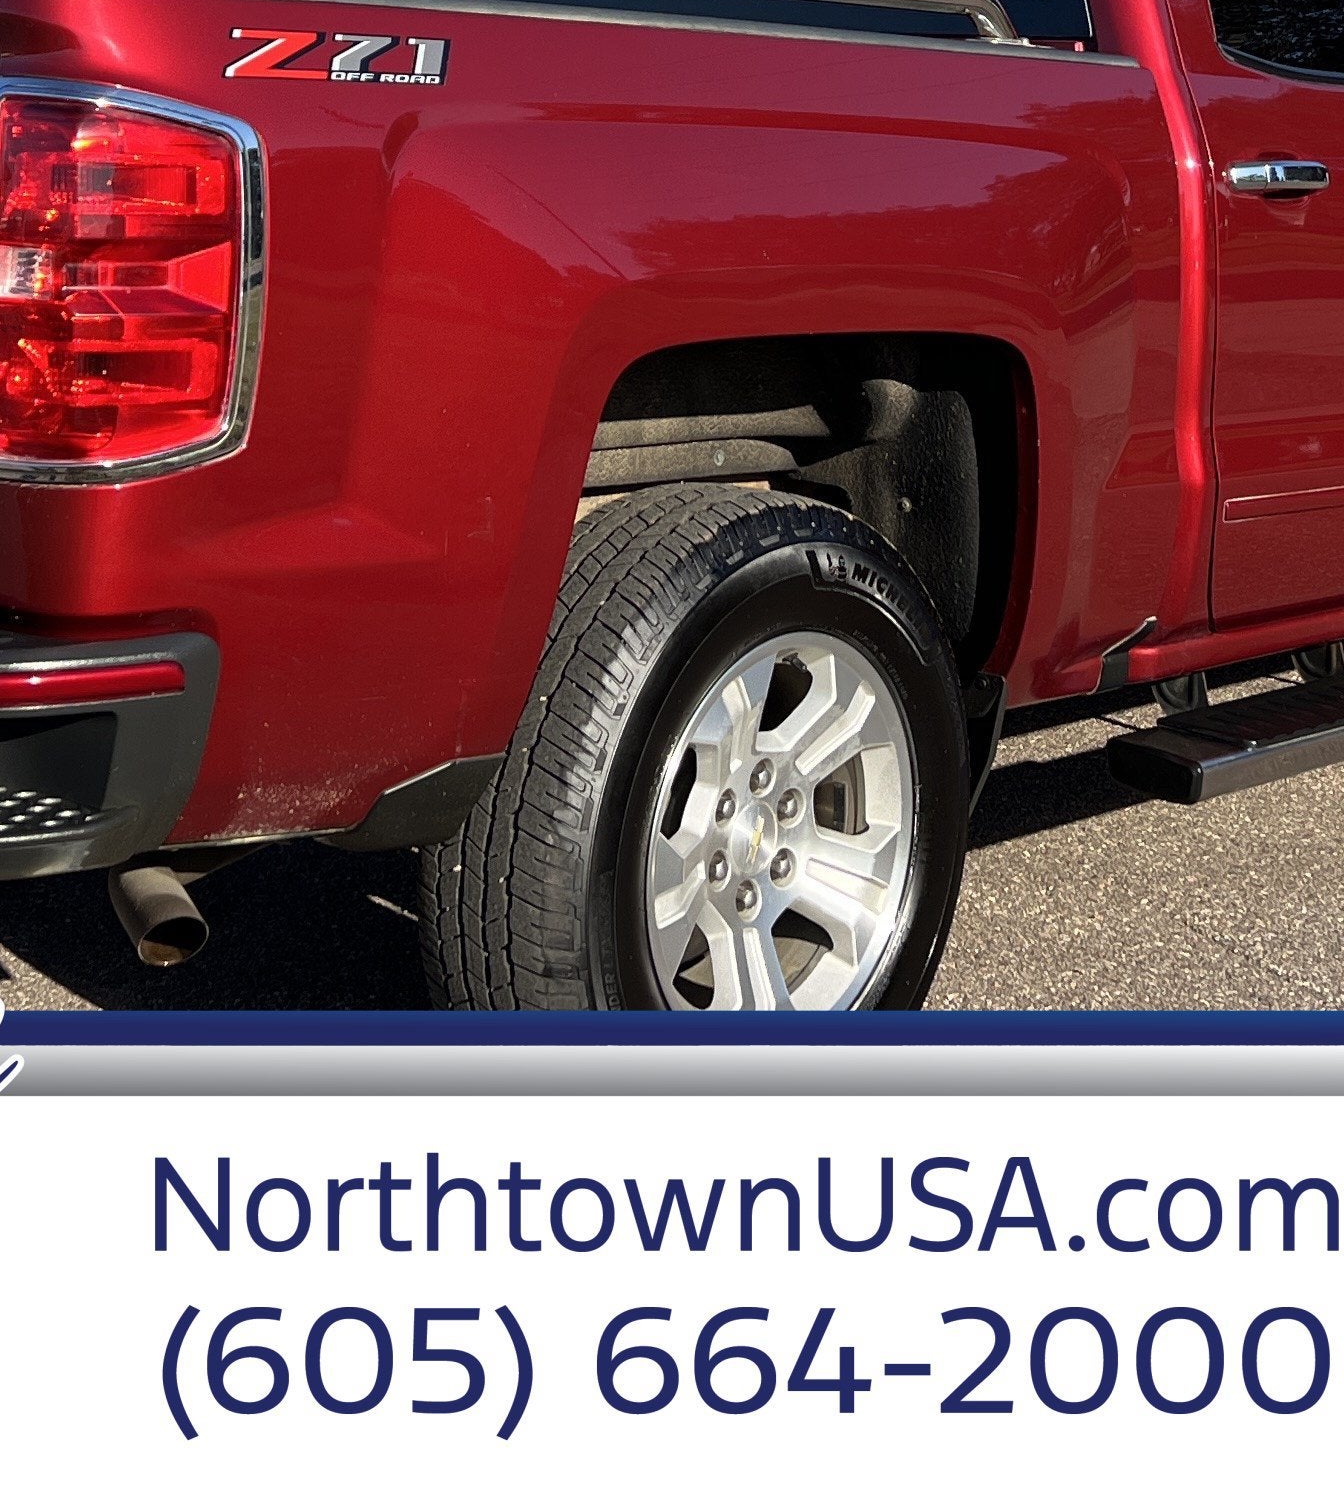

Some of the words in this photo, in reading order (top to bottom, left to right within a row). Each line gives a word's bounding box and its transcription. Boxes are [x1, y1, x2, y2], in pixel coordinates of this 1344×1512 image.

[222, 27, 451, 82] Z71
[330, 71, 374, 82] OFF
[379, 72, 442, 85] ROAD
